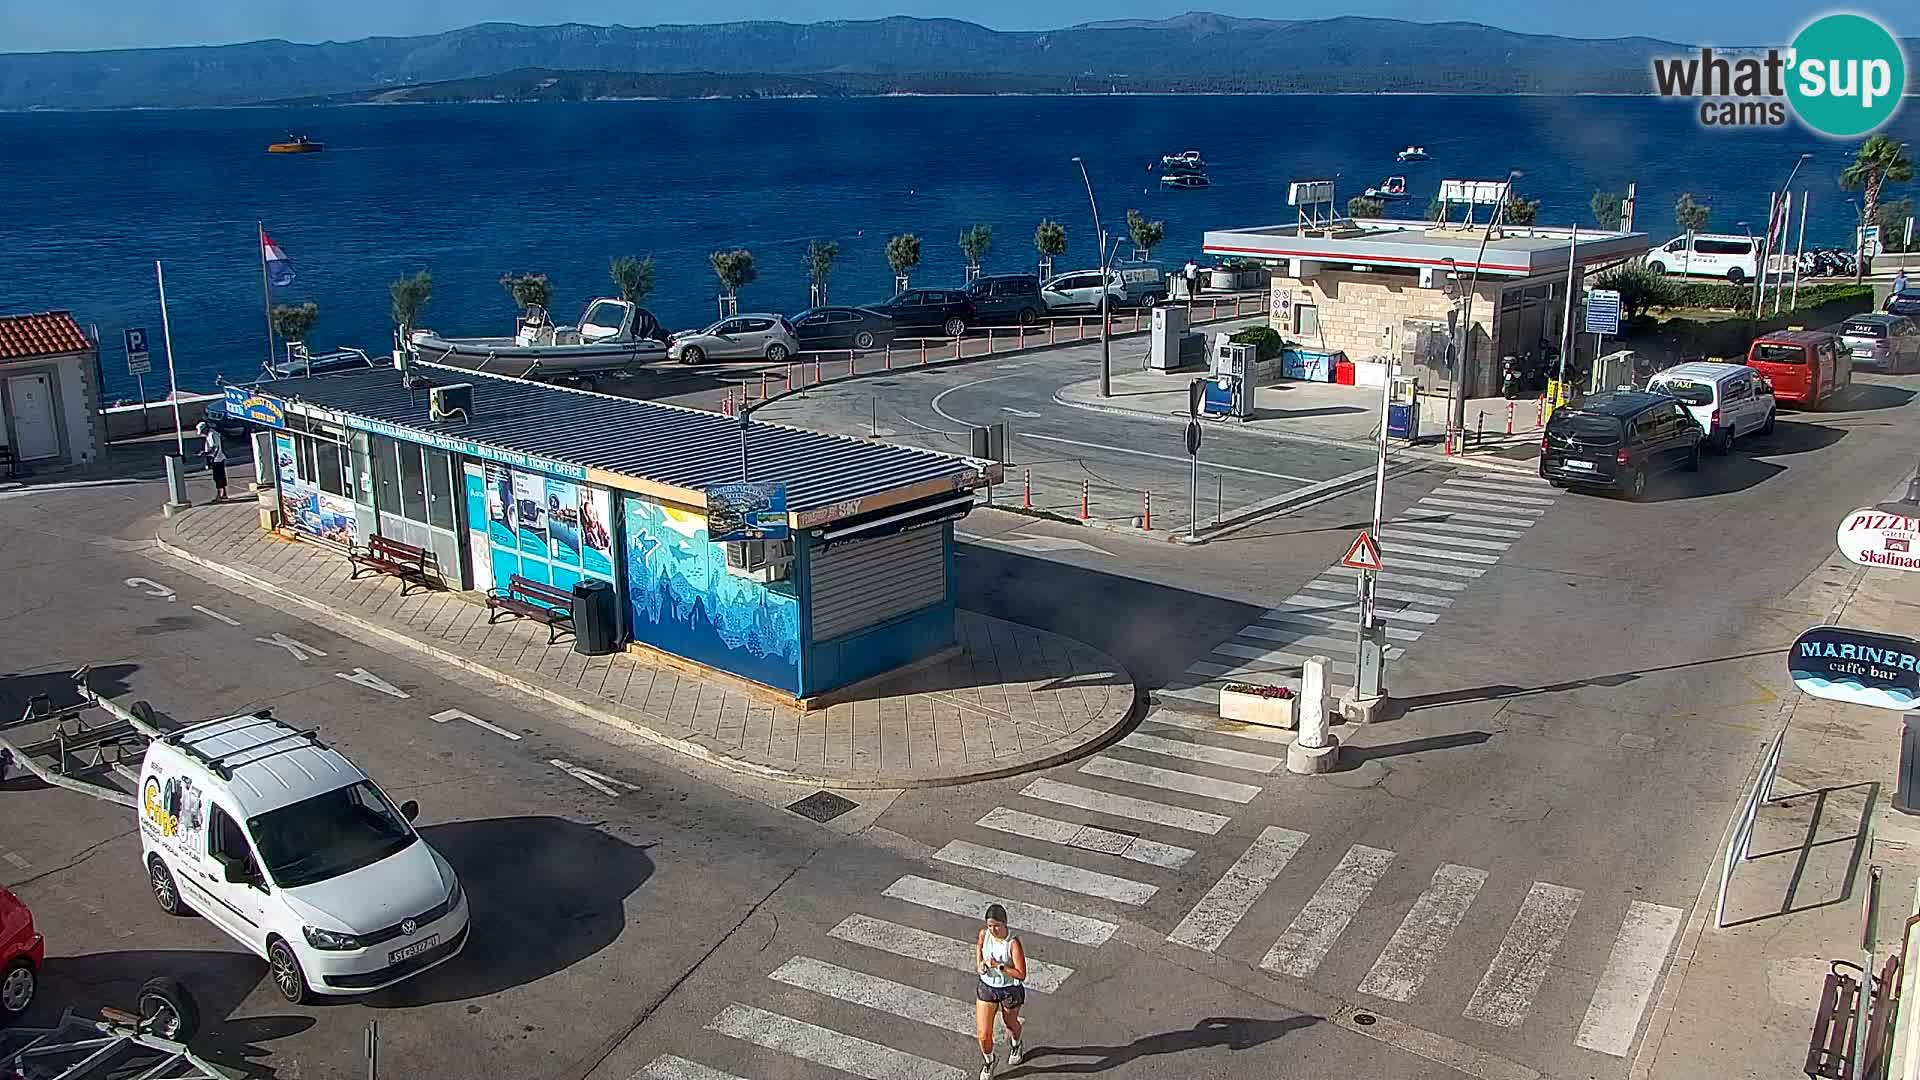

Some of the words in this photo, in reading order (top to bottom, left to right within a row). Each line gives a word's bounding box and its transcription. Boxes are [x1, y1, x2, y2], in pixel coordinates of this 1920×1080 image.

[129, 331, 142, 350] P
[1672, 381, 1692, 389] TAXI
[477, 445, 493, 459] BUS
[493, 449, 526, 465] STATION
[527, 456, 554, 472] TICKET
[555, 462, 582, 477] OFFICE
[1848, 514, 1920, 533] PIZZE
[1829, 661, 1866, 676] caffe
[1870, 665, 1897, 681] bar
